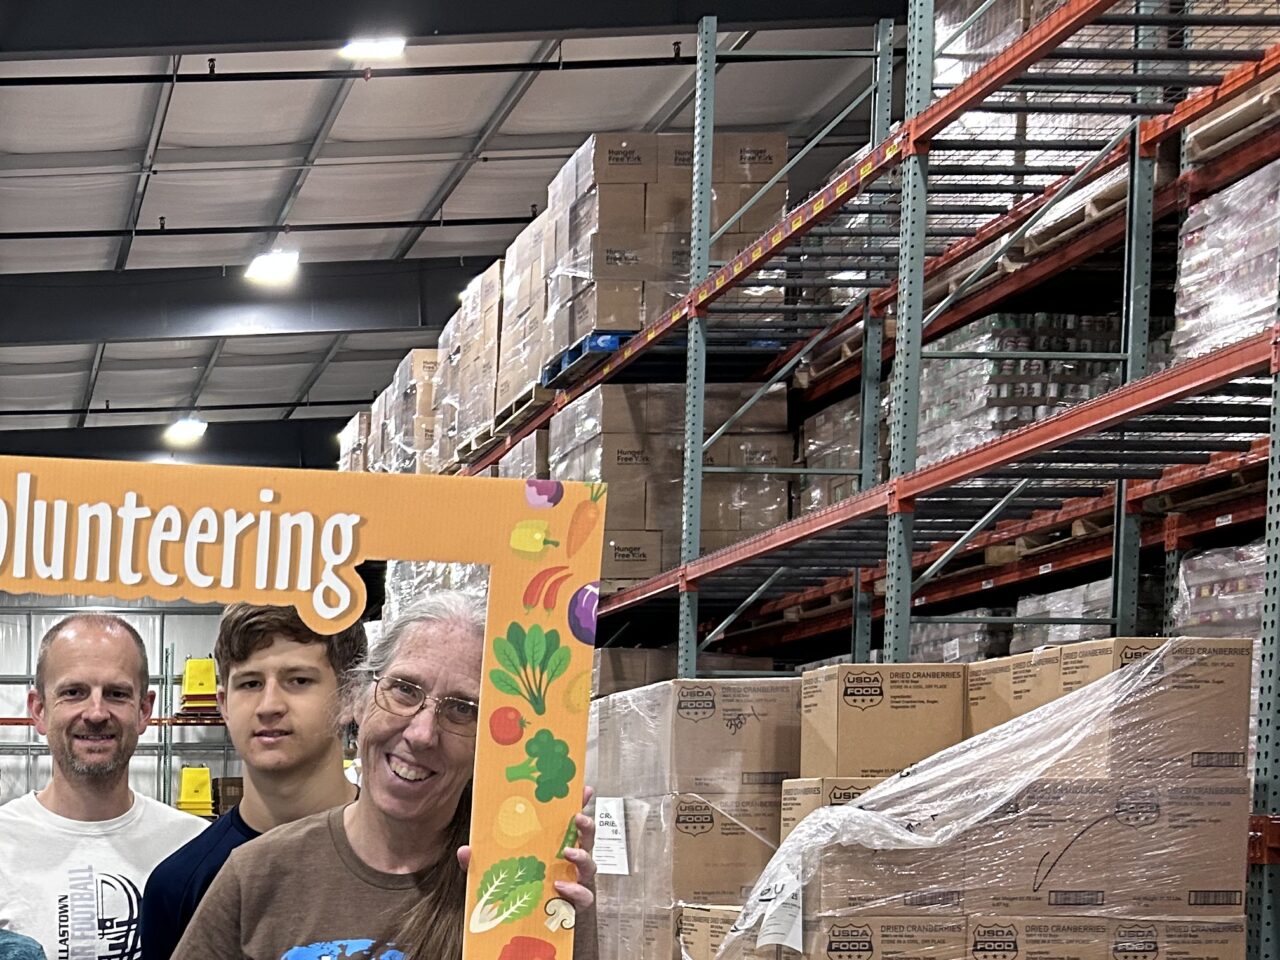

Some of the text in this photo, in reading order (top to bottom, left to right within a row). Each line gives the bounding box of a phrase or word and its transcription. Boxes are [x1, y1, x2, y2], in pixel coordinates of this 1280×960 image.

[608, 149, 635, 158] Hunger
[675, 150, 693, 158] Hung
[608, 155, 624, 163] Free
[617, 449, 644, 458] Hunger
[617, 455, 633, 463] Free
[614, 546, 640, 555] Hunger
[614, 552, 630, 560] Free
[1197, 648, 1250, 657] CRANBERRIES
[889, 671, 961, 679] DRIED CRANBERRIES
[680, 690, 712, 698] USDA
[847, 687, 880, 695] FOOD
[833, 792, 861, 800] USD
[679, 804, 710, 813] USDA
[679, 815, 710, 823] FOOD
[68, 864, 96, 940] FOOTBALL
[881, 925, 962, 933] DRIED CRANBERRIES
[1025, 925, 1106, 933] DRIED CRANBERRIES
[977, 942, 1014, 950] FOOD
